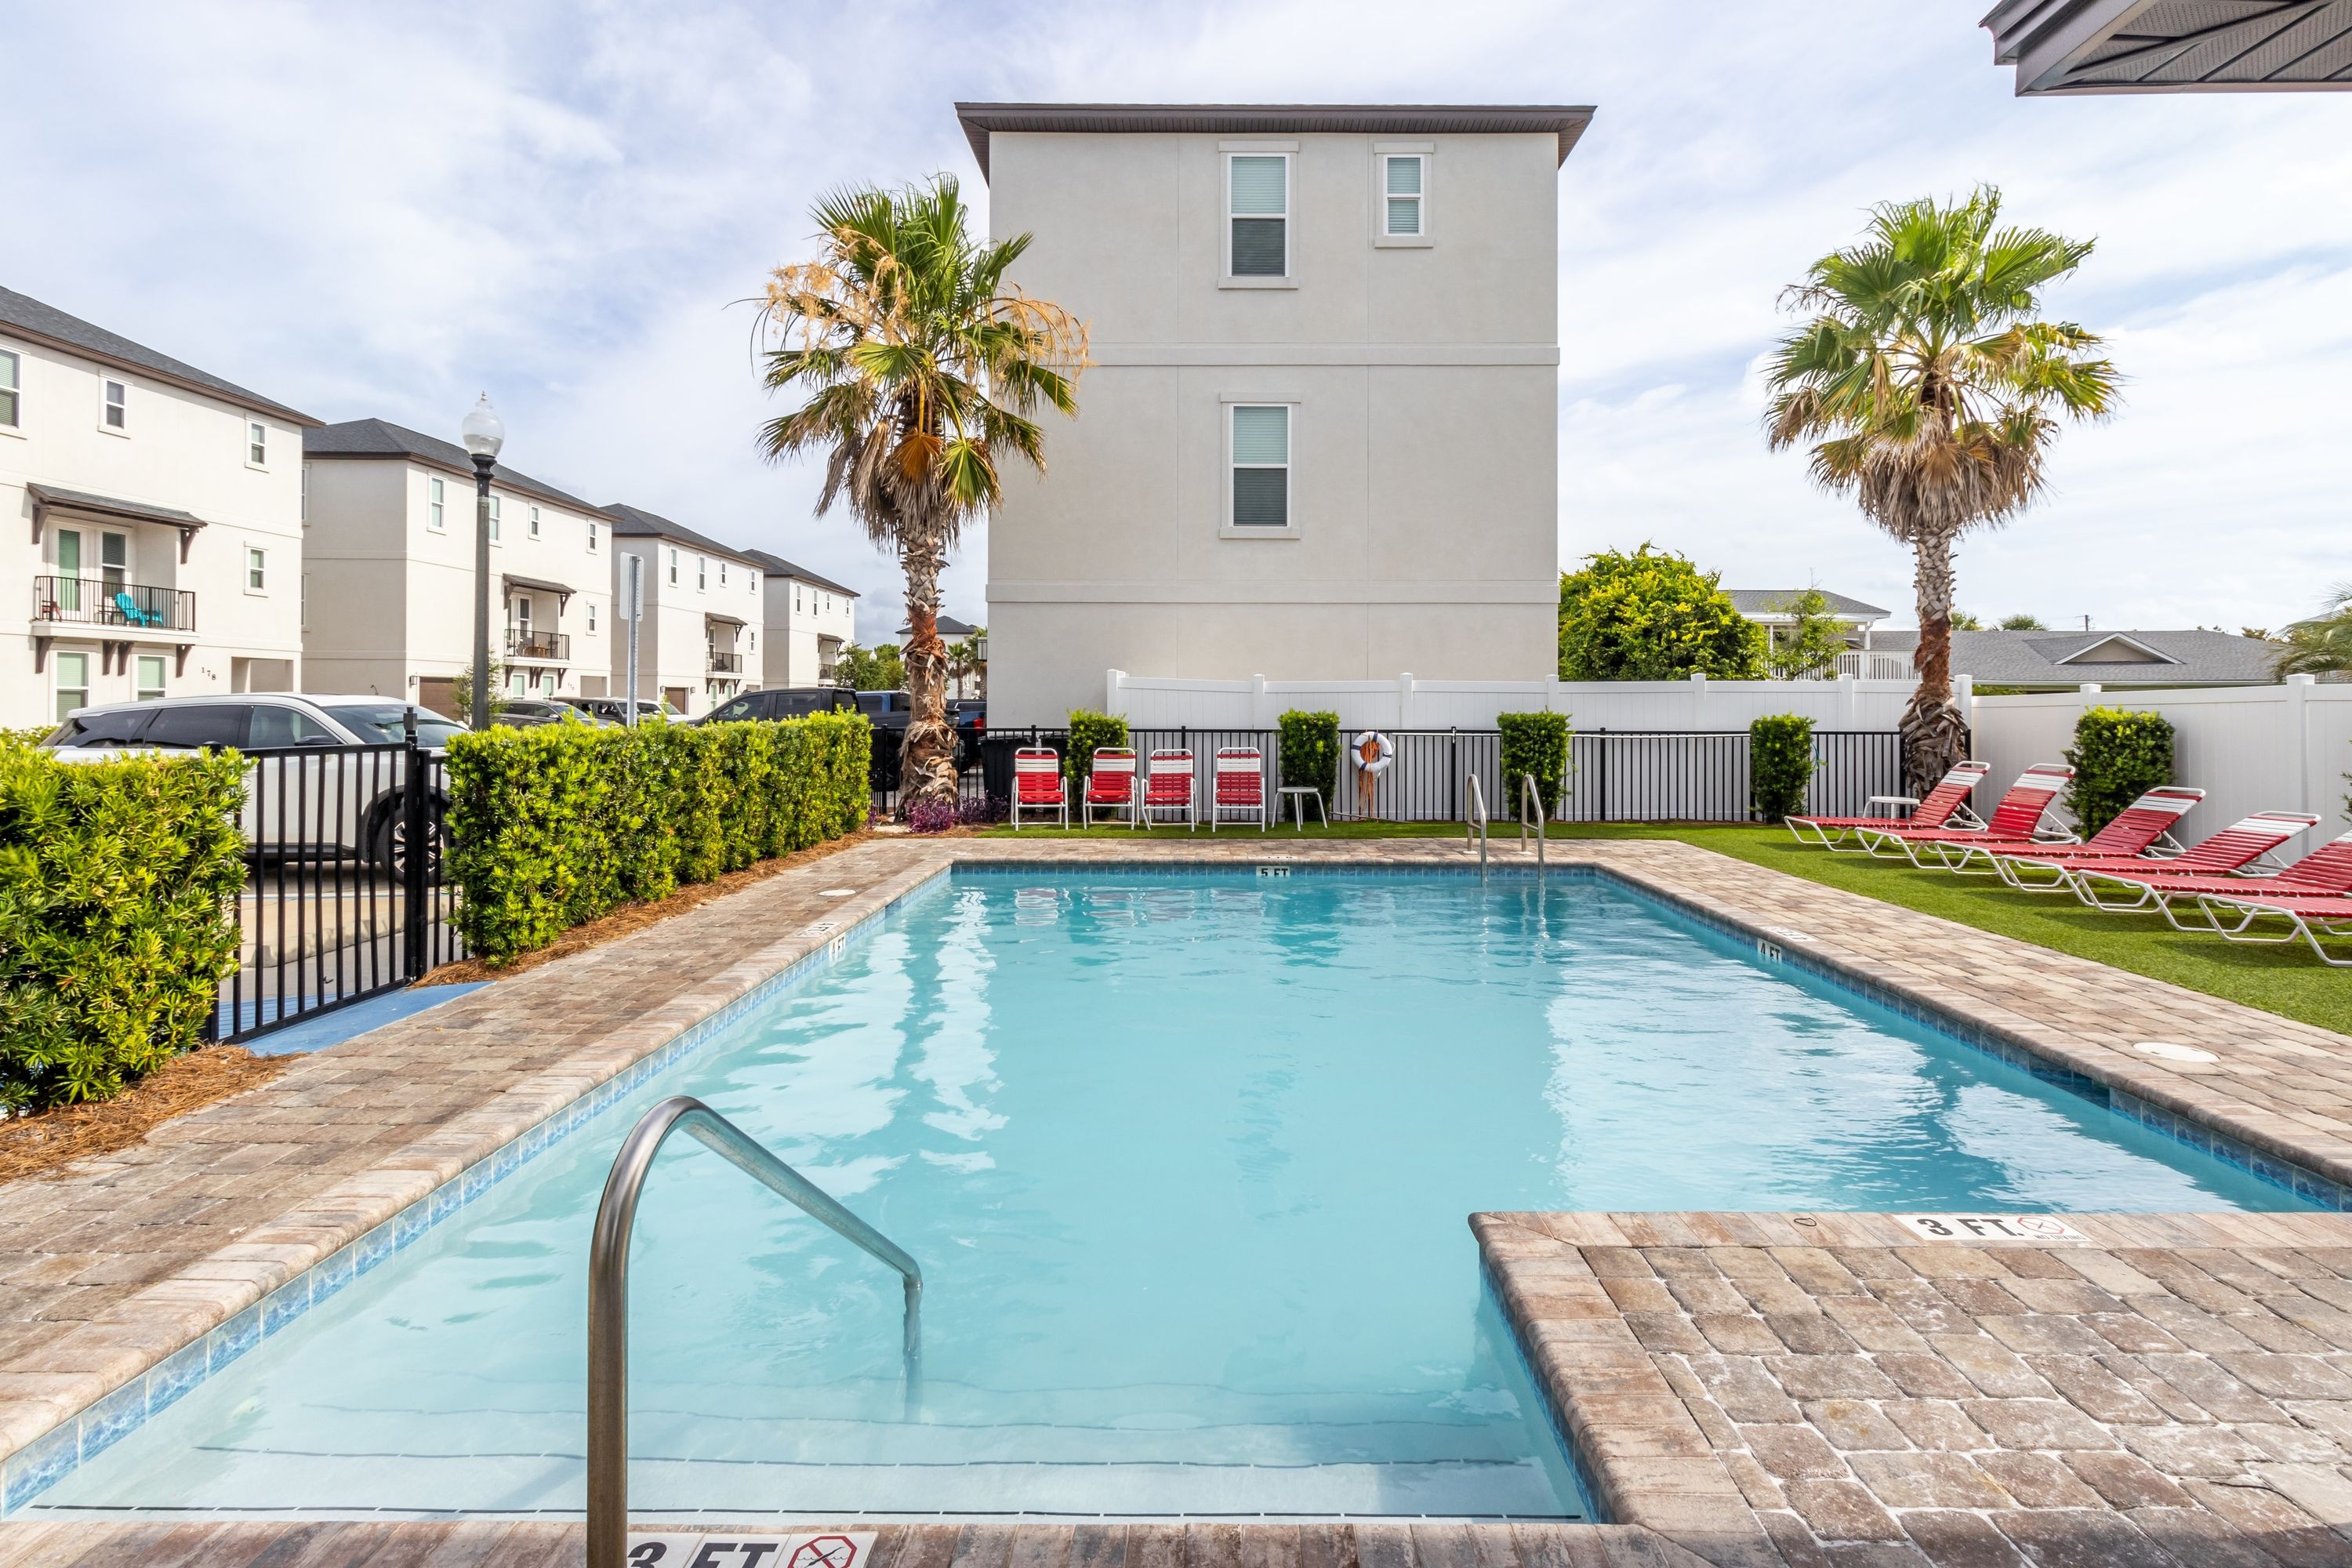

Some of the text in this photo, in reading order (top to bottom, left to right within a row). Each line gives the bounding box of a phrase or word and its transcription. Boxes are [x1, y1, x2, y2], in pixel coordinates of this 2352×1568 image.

[201, 666, 216, 681] 178
[1261, 868, 1288, 877] 5 FT
[1769, 946, 1780, 960] FT
[1916, 1218, 1955, 1236] 3
